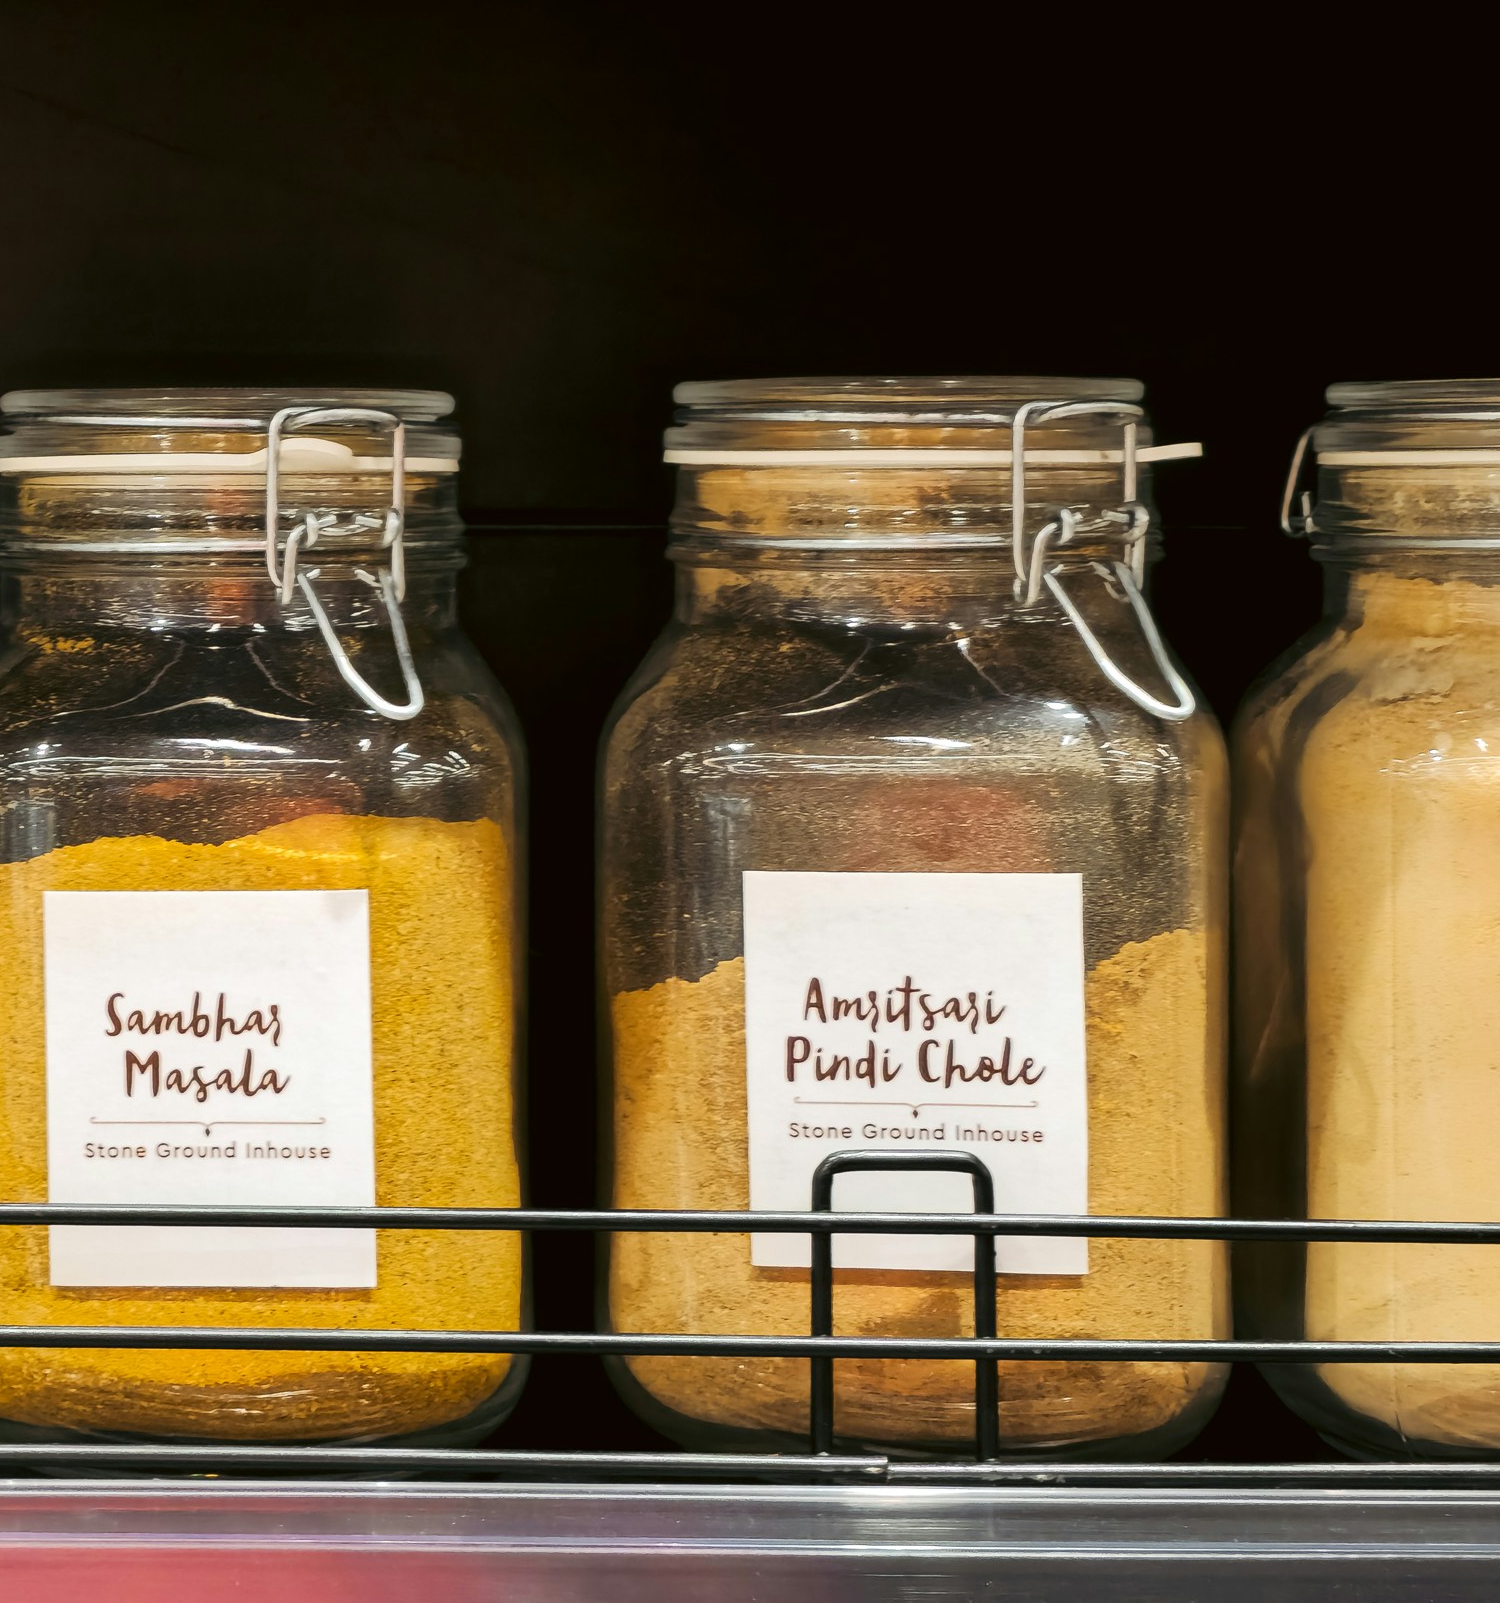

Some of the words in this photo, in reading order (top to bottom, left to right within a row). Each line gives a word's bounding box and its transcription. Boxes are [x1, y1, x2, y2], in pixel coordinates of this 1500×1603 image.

[105, 991, 282, 1045] Sambhar
[803, 975, 1007, 1034] Amritsari
[124, 1048, 291, 1103] Masala
[786, 1036, 903, 1088] Pindi
[918, 1037, 1046, 1089] Chole
[84, 1142, 148, 1159] Stone
[154, 1141, 237, 1159] Ground
[245, 1141, 332, 1160] Inhouse
[788, 1123, 854, 1139] Stone
[861, 1123, 946, 1140] Ground
[955, 1123, 1045, 1143] Inhouse
